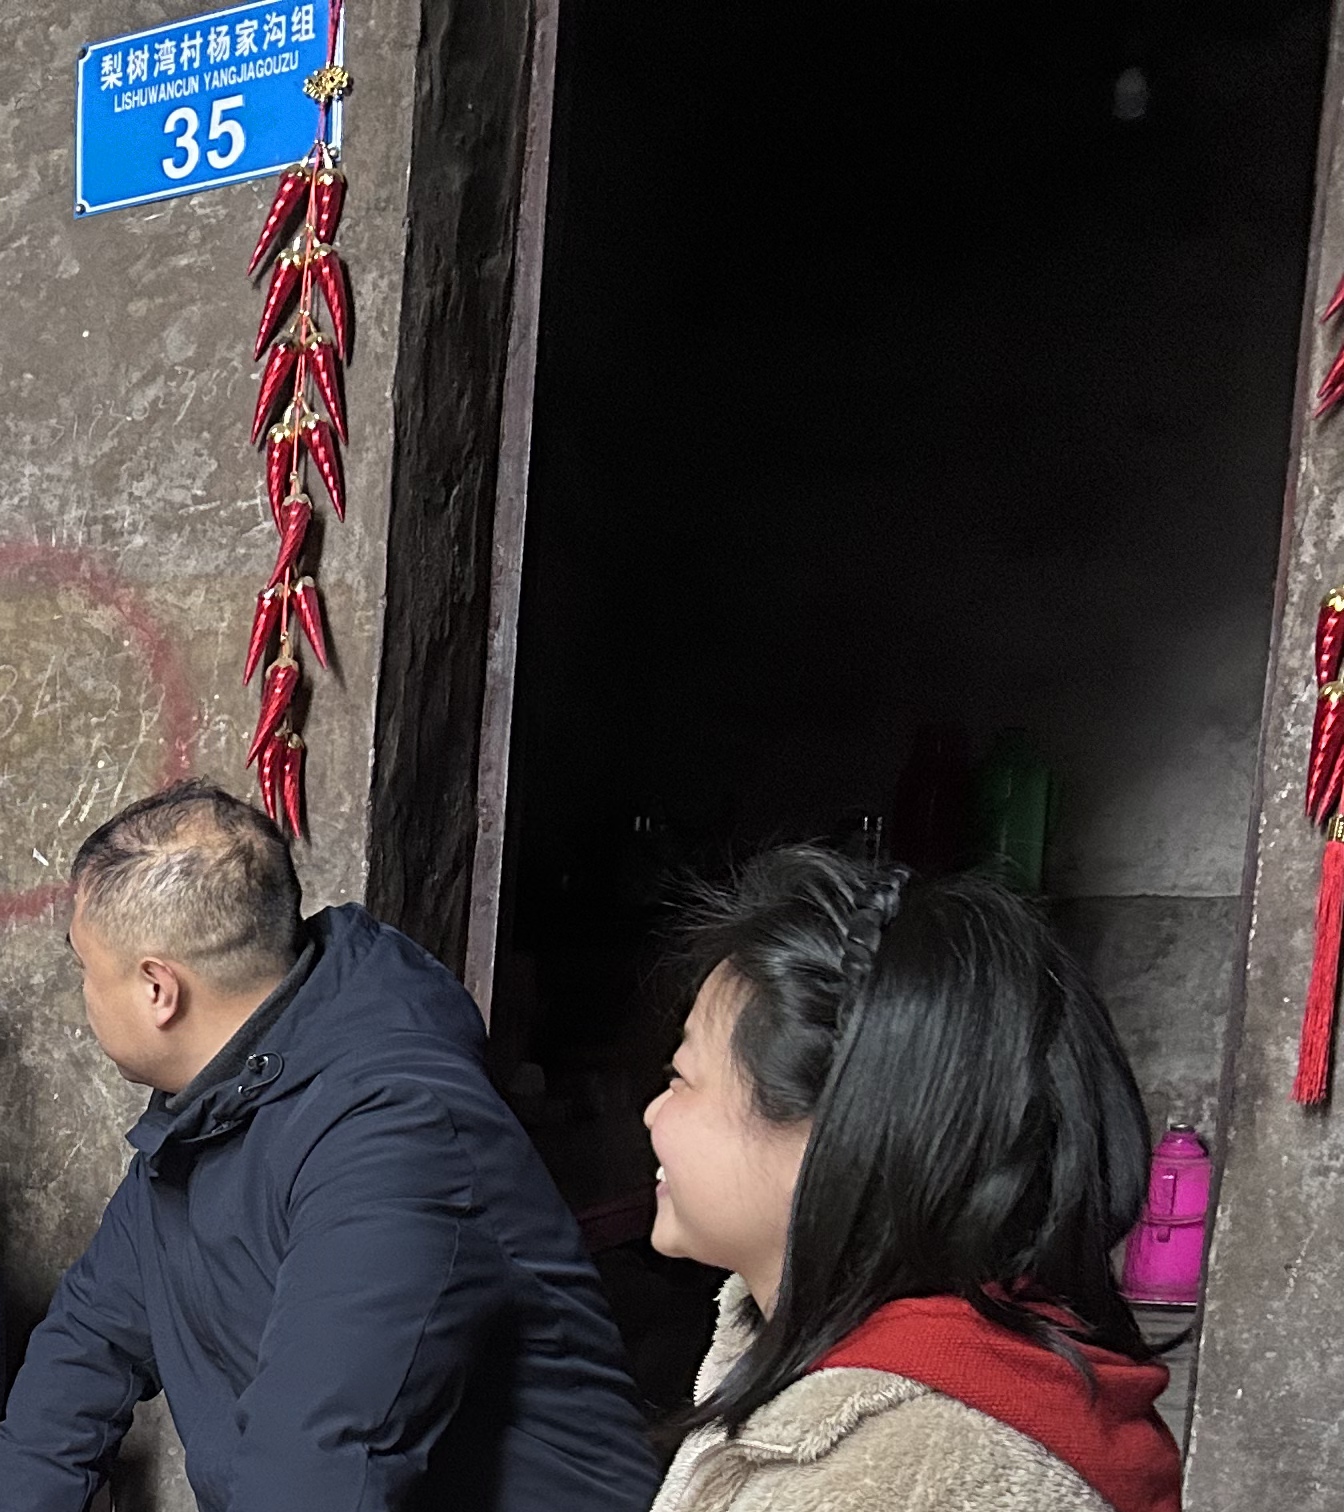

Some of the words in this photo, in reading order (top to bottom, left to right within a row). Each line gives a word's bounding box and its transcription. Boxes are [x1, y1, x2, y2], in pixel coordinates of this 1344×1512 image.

[100, 4, 316, 92] 梨树湾村杨家沟组
[114, 78, 200, 113] LISHUWANCUN
[204, 51, 299, 90] YANGJIAGOUZU
[162, 95, 246, 181] 35
